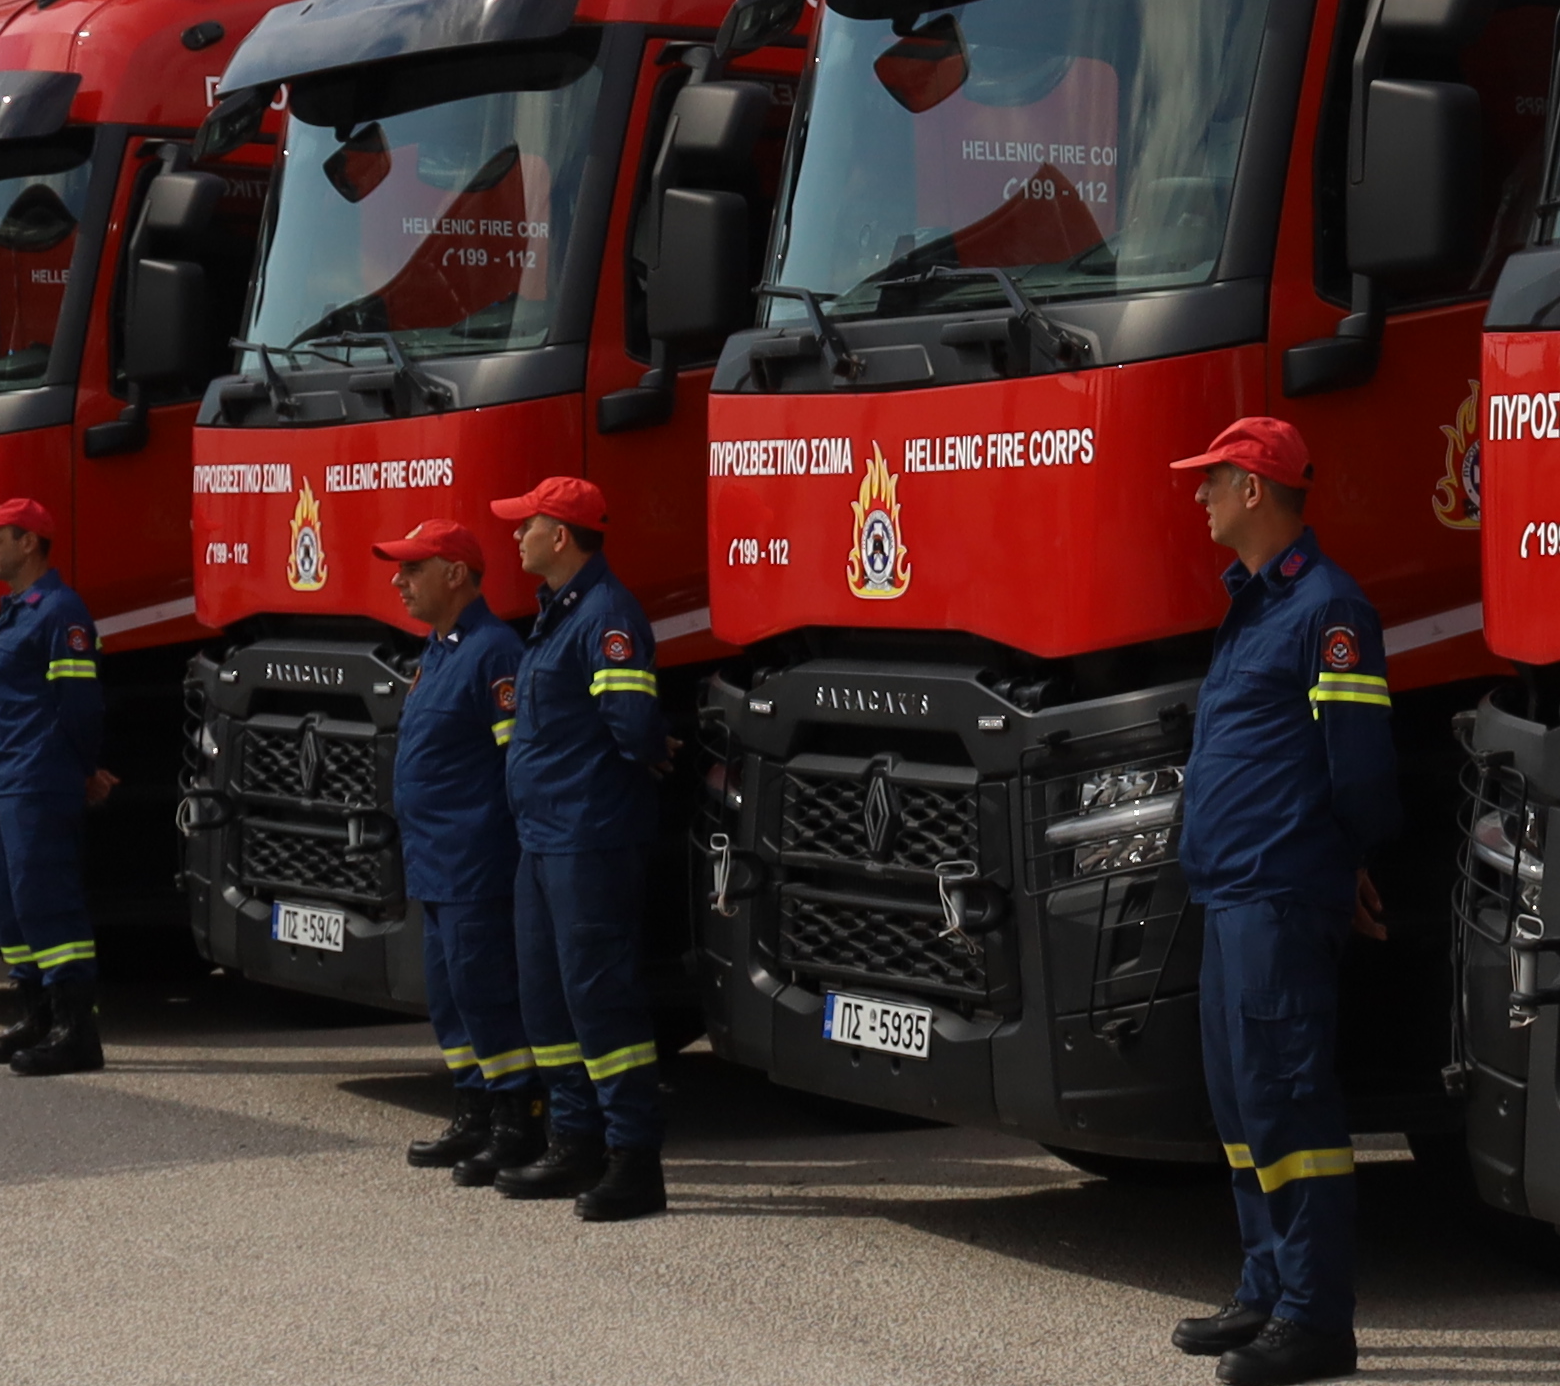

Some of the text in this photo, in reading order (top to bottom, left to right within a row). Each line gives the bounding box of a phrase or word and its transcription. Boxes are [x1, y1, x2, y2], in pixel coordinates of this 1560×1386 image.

[962, 140, 1045, 163] HELLENIC
[1050, 144, 1086, 164] FIRE
[1019, 178, 1055, 200] 199
[1075, 180, 1108, 203] 112
[402, 217, 476, 235] HELLENIC
[479, 220, 512, 236] FIRE
[457, 248, 488, 266] 199
[506, 251, 536, 268] 112
[709, 437, 852, 477] ΠΥΡΟΣΒΕΣΤΙΚΟ ΣΩΜΑ
[905, 428, 1094, 473] HELLENIC FIRE CORPS
[325, 458, 453, 492] HELLENIC FIRE CORPS
[738, 539, 758, 565] 199
[768, 539, 789, 565] 112
